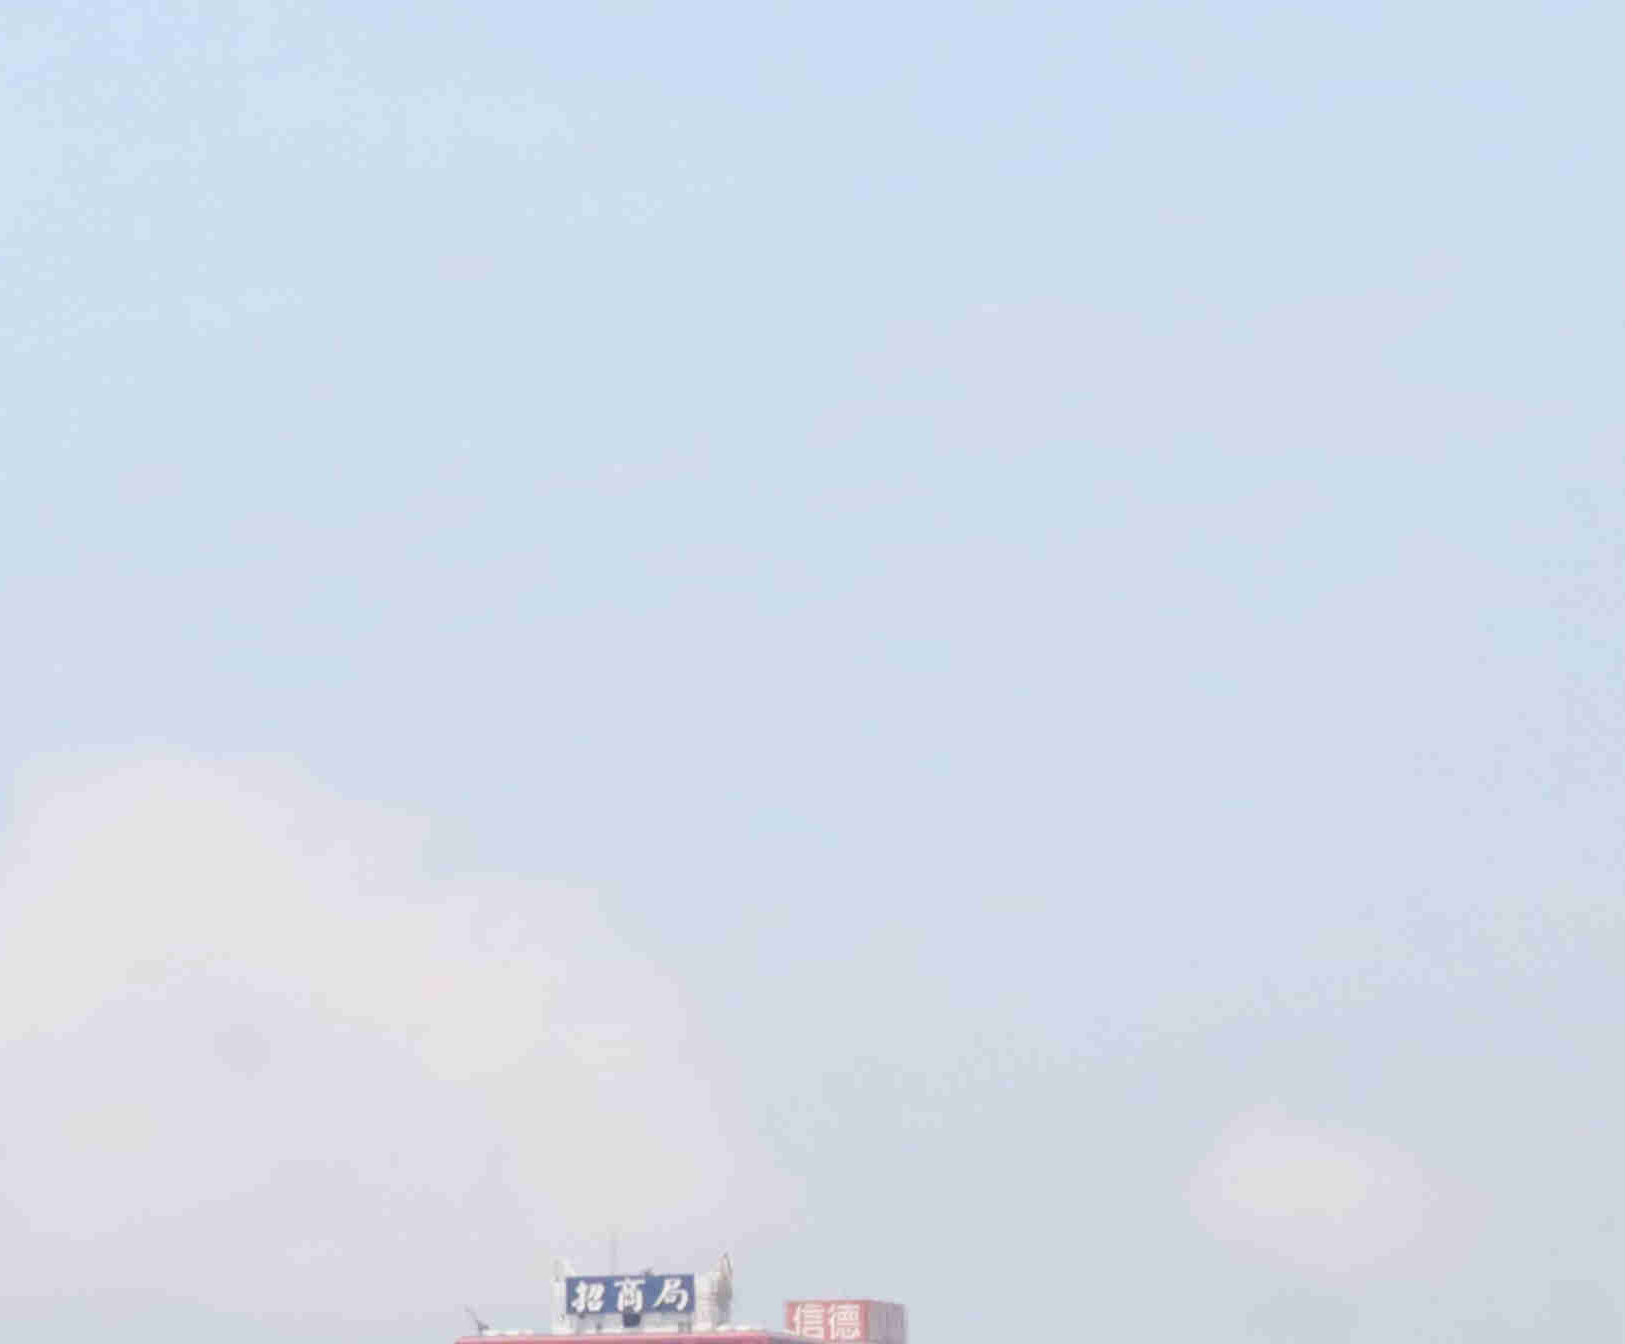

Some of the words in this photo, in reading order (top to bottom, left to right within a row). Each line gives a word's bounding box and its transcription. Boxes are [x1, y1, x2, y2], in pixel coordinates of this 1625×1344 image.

[571, 1278, 689, 1313] 招商局
[792, 1302, 862, 1340] 信德
